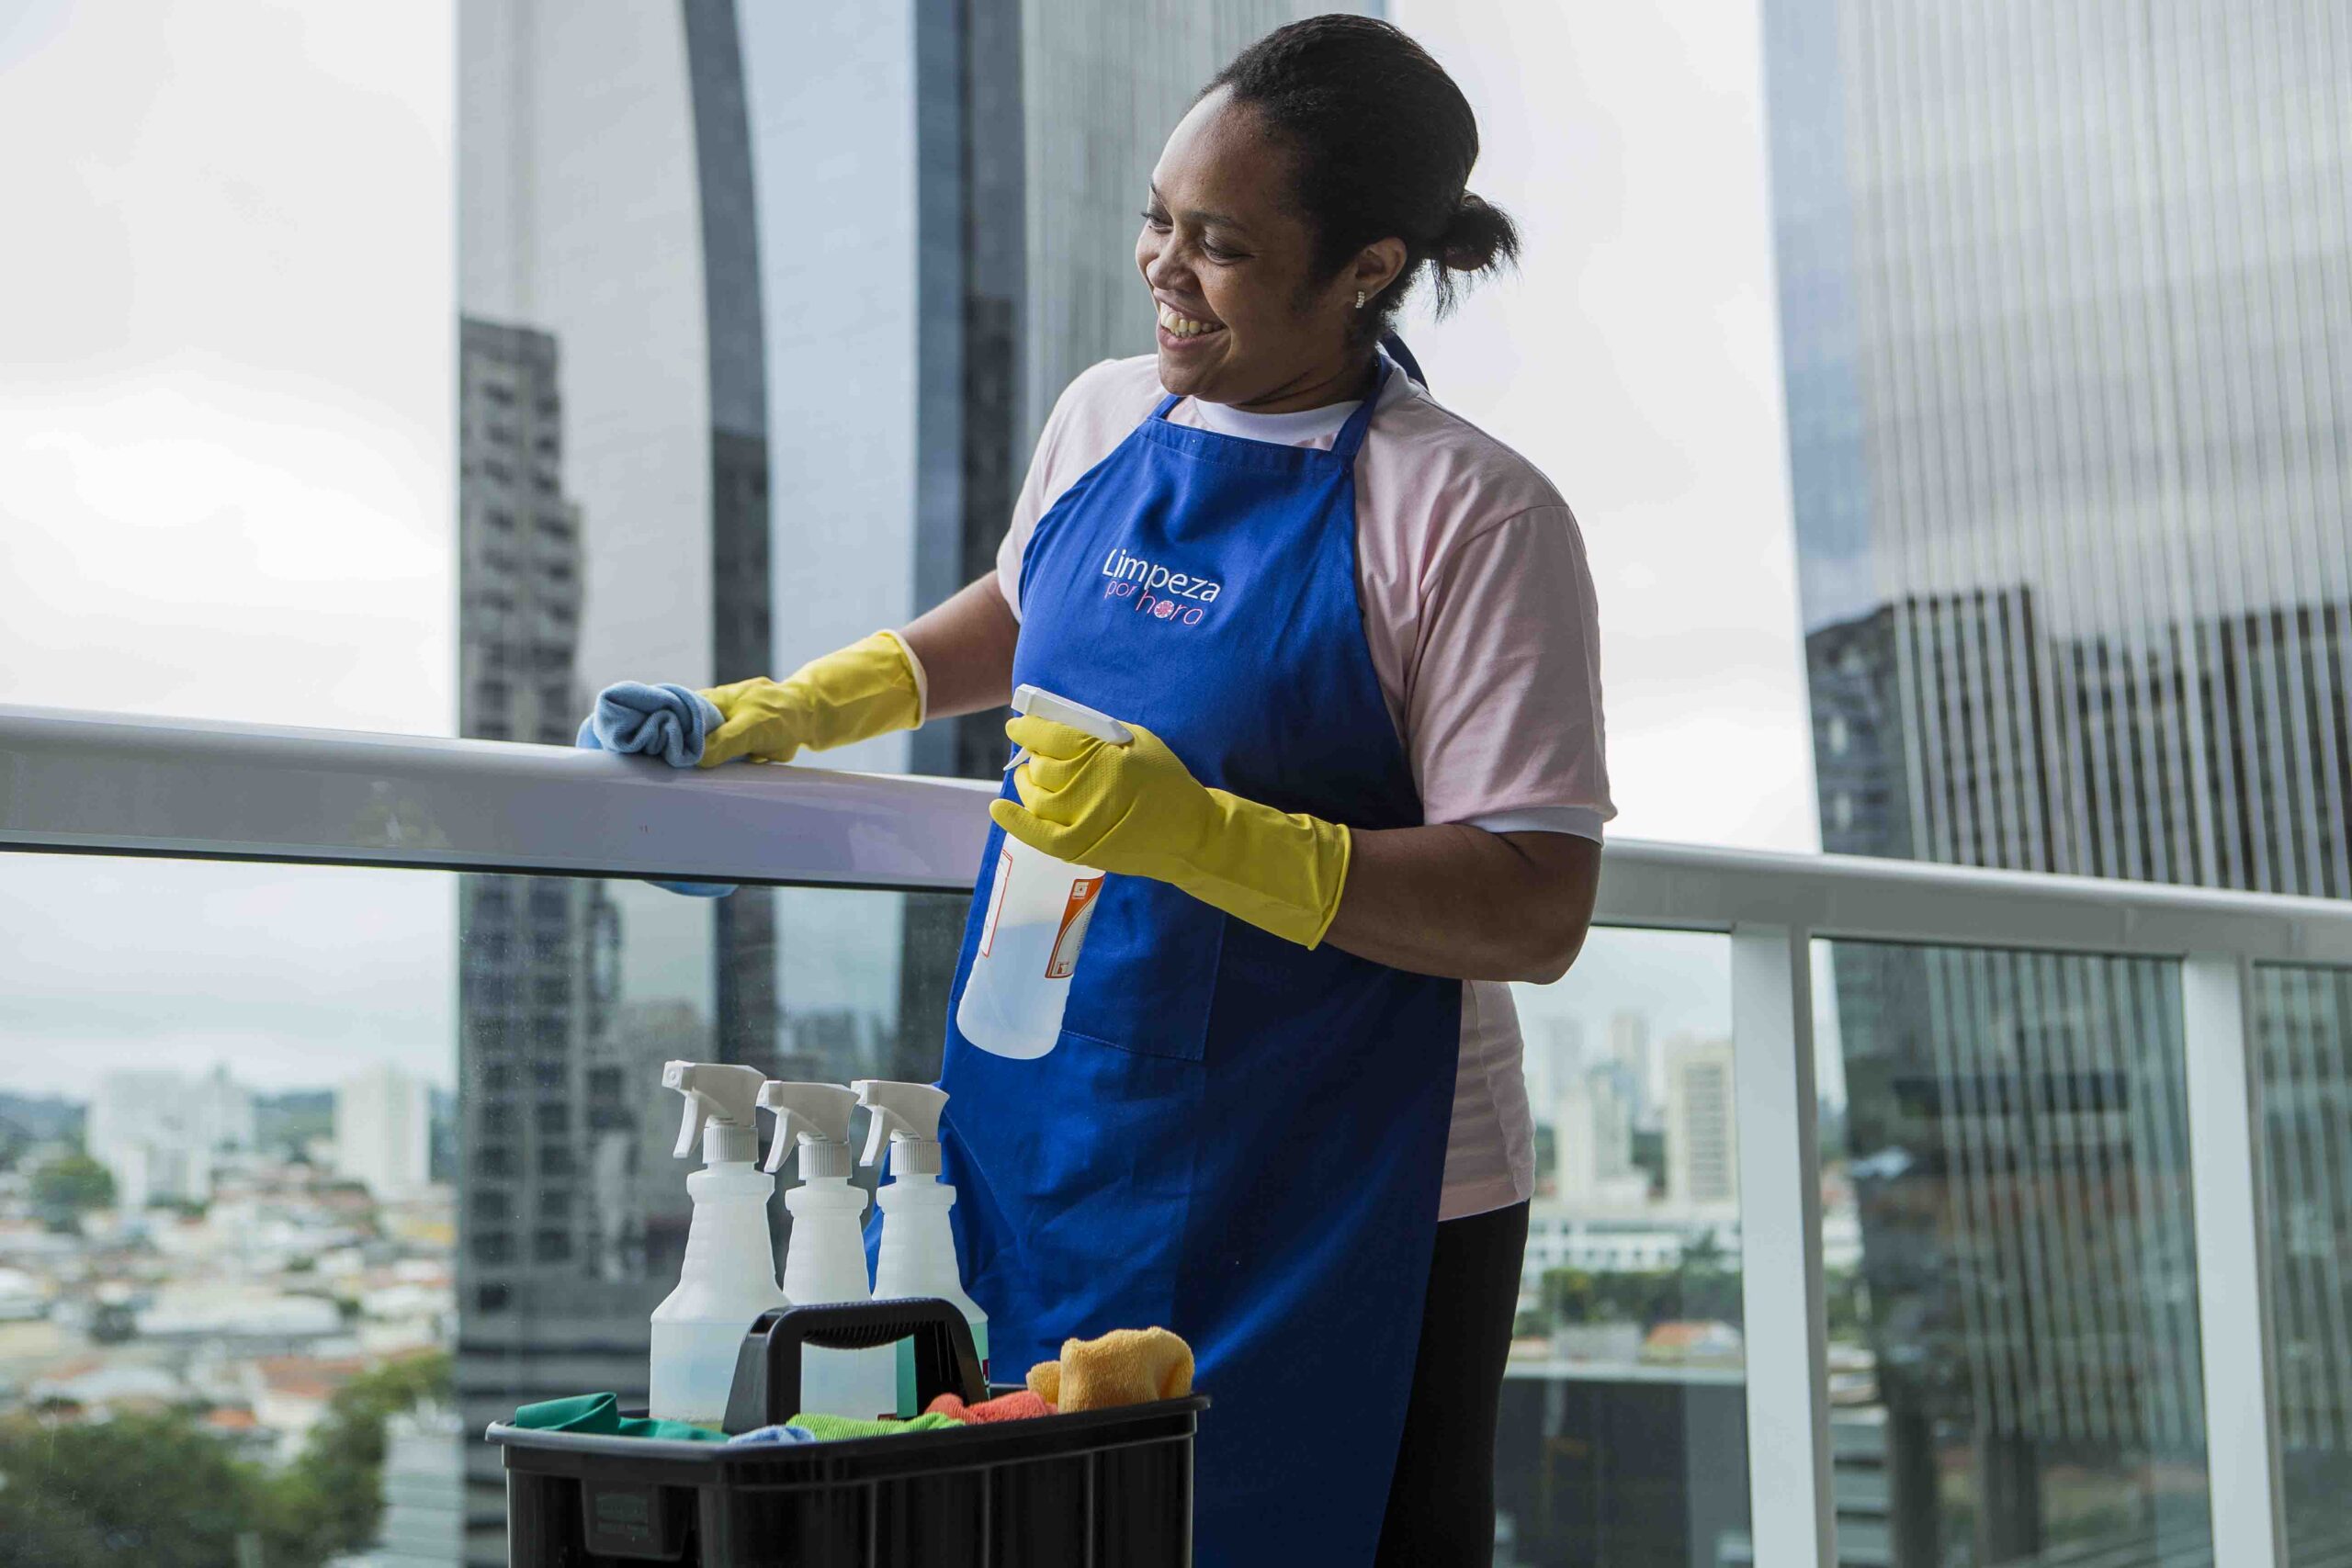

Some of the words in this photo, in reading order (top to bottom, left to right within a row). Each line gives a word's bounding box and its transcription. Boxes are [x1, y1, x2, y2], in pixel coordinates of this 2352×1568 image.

[1102, 548, 1221, 603] Limpeza
[1104, 581, 1137, 600] por
[1135, 590, 1204, 626] hora
